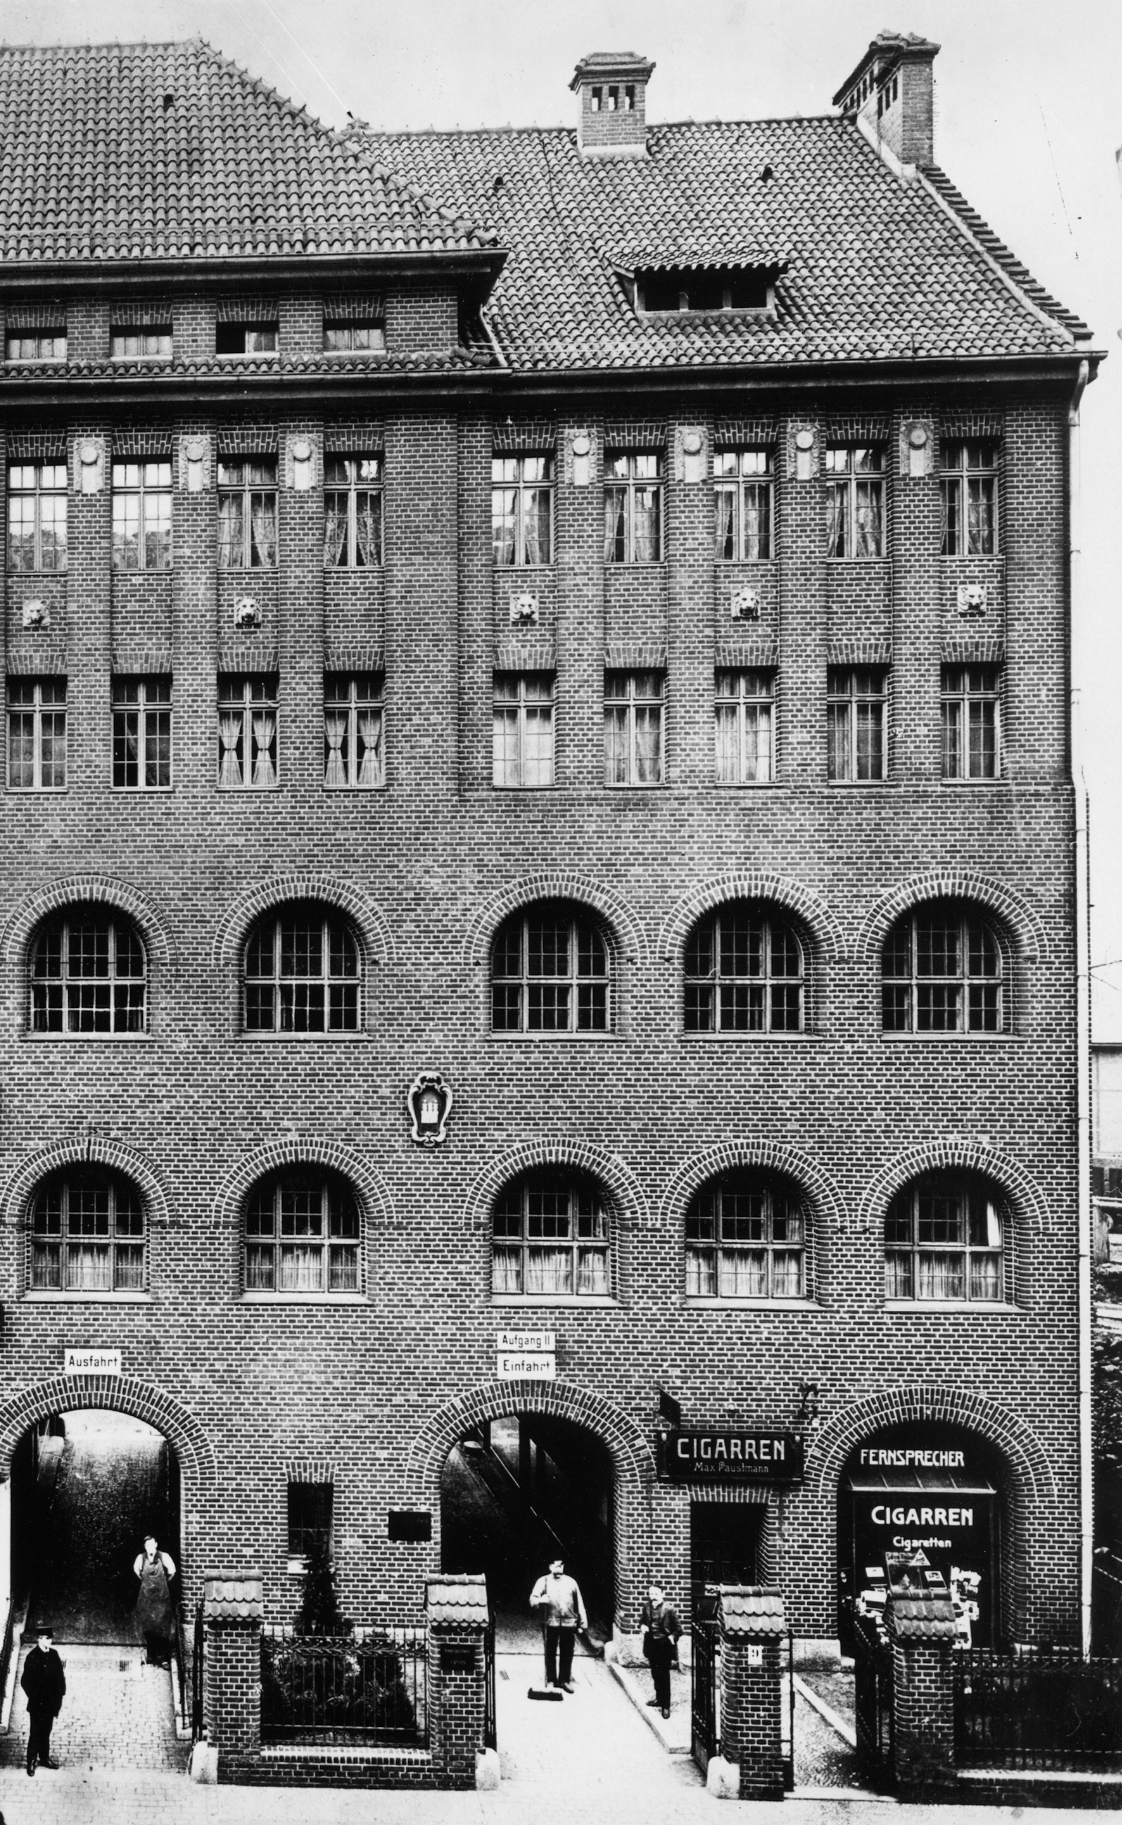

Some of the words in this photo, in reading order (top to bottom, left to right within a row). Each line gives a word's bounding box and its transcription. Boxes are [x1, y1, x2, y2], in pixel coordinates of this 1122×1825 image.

[502, 1334, 542, 1349] Aufgang
[68, 1355, 118, 1368] Ausfahrt
[503, 1359, 550, 1372] Einfahrt
[677, 1438, 785, 1461] CIGARREN
[860, 1449, 965, 1467] FERNSPRECHER
[694, 1461, 716, 1472] Max
[871, 1505, 973, 1526] CIGARREN
[893, 1536, 952, 1551] Cigaretten
